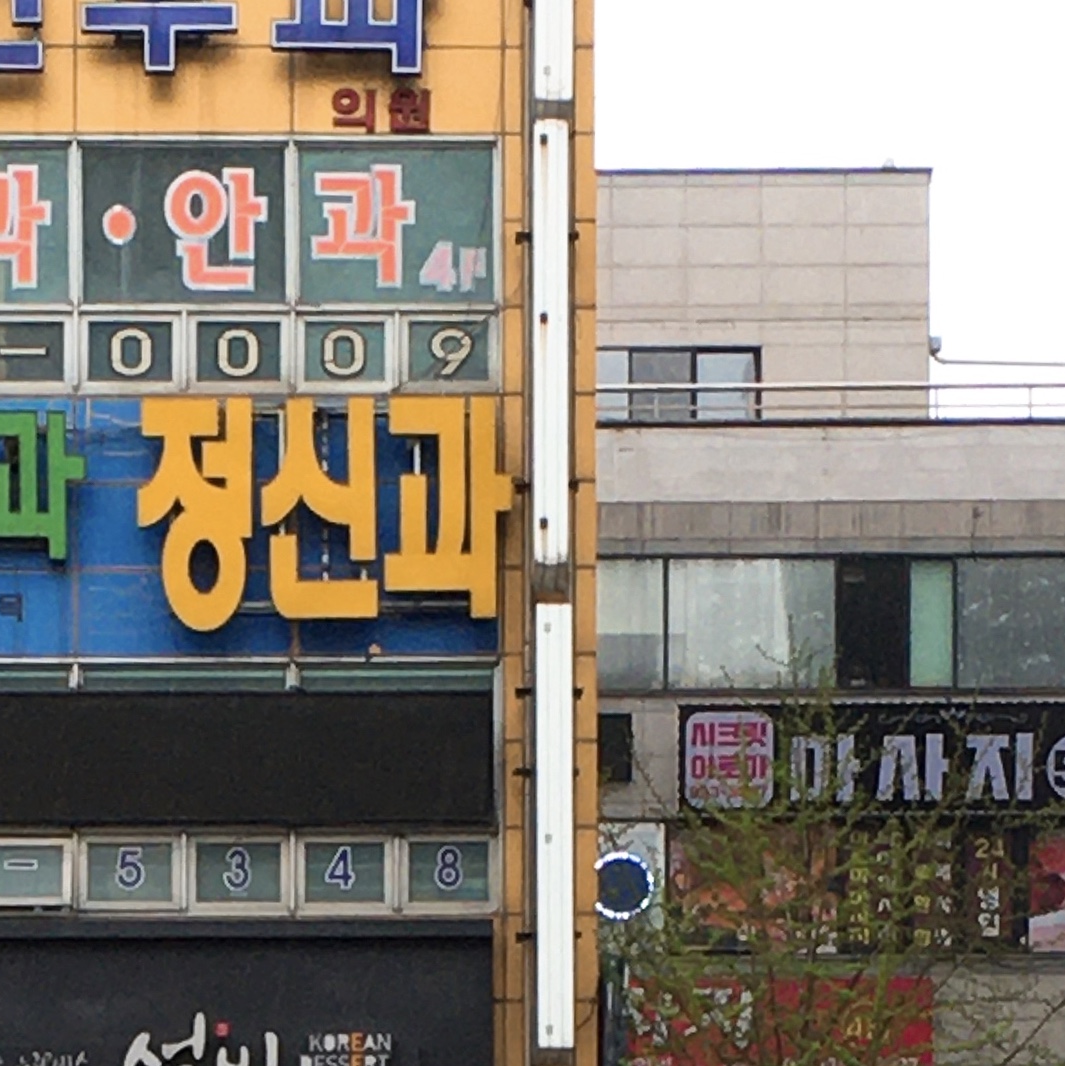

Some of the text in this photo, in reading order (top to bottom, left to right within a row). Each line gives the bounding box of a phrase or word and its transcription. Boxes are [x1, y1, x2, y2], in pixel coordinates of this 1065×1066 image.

[332, 87, 431, 134] 의원
[136, 396, 513, 633] 정신과
[789, 732, 1034, 801] 마사지
[308, 1032, 392, 1053] KOREAN
